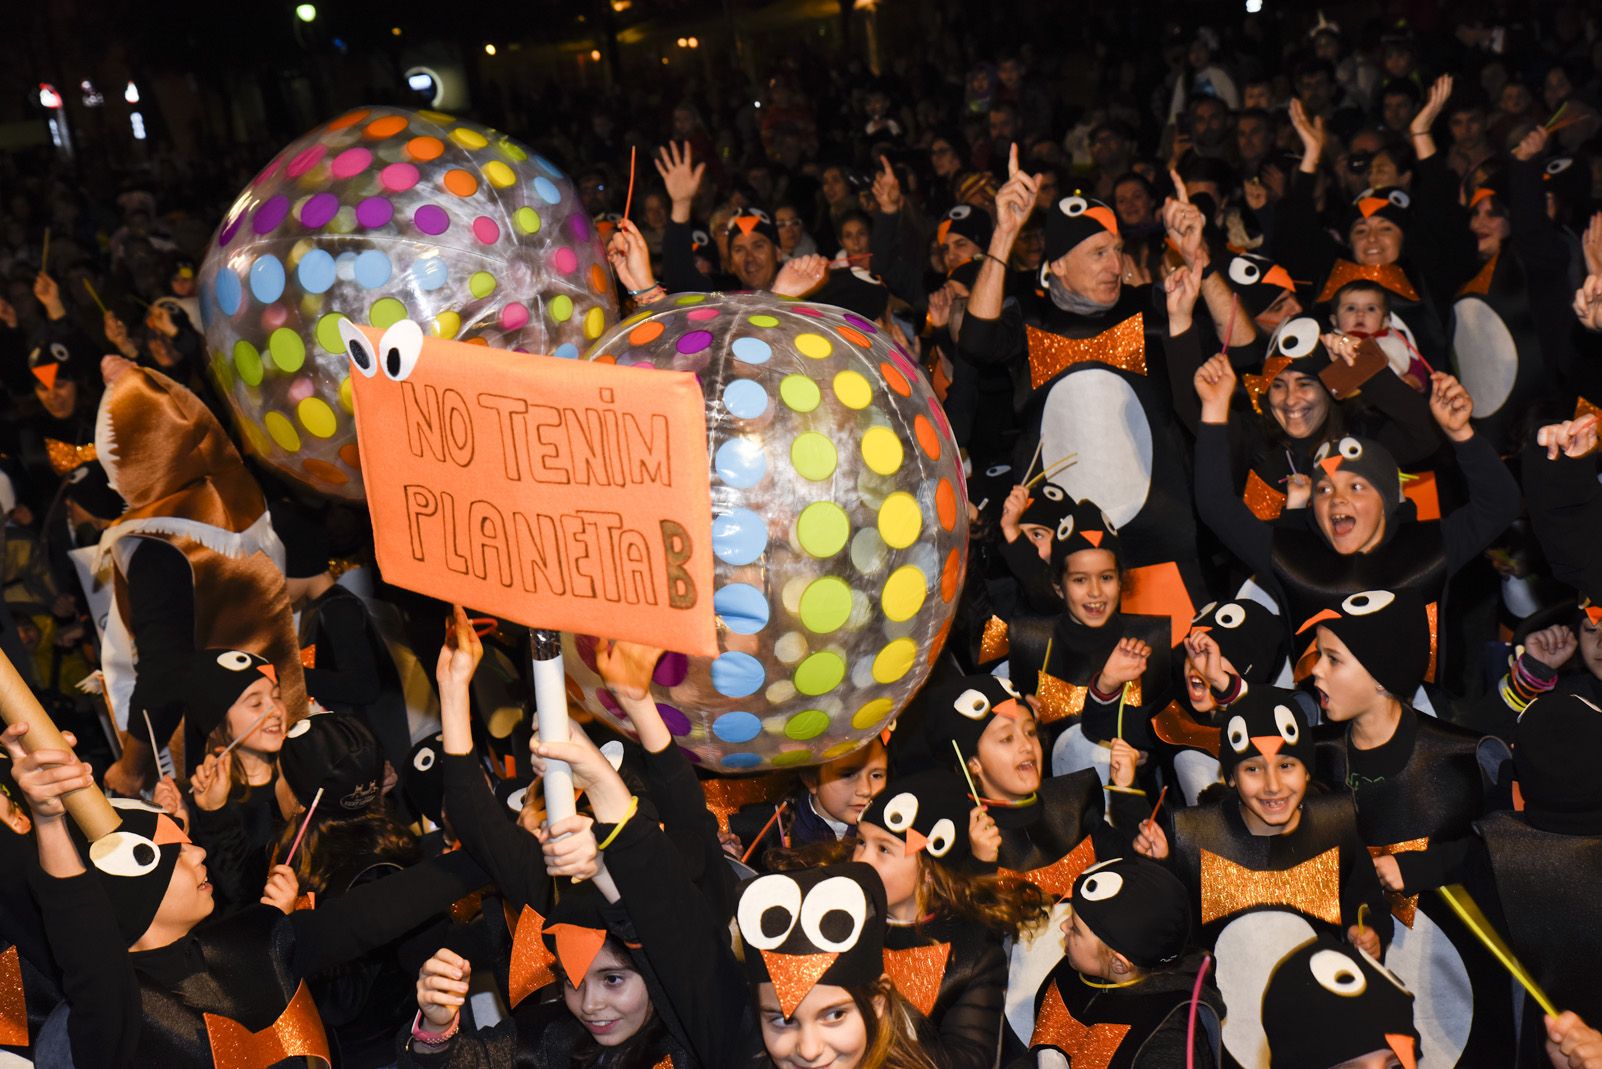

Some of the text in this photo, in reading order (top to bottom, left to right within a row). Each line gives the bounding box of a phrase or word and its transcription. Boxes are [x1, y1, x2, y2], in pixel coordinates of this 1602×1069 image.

[400, 380, 474, 468] NO
[403, 484, 698, 610] PLANETA B
